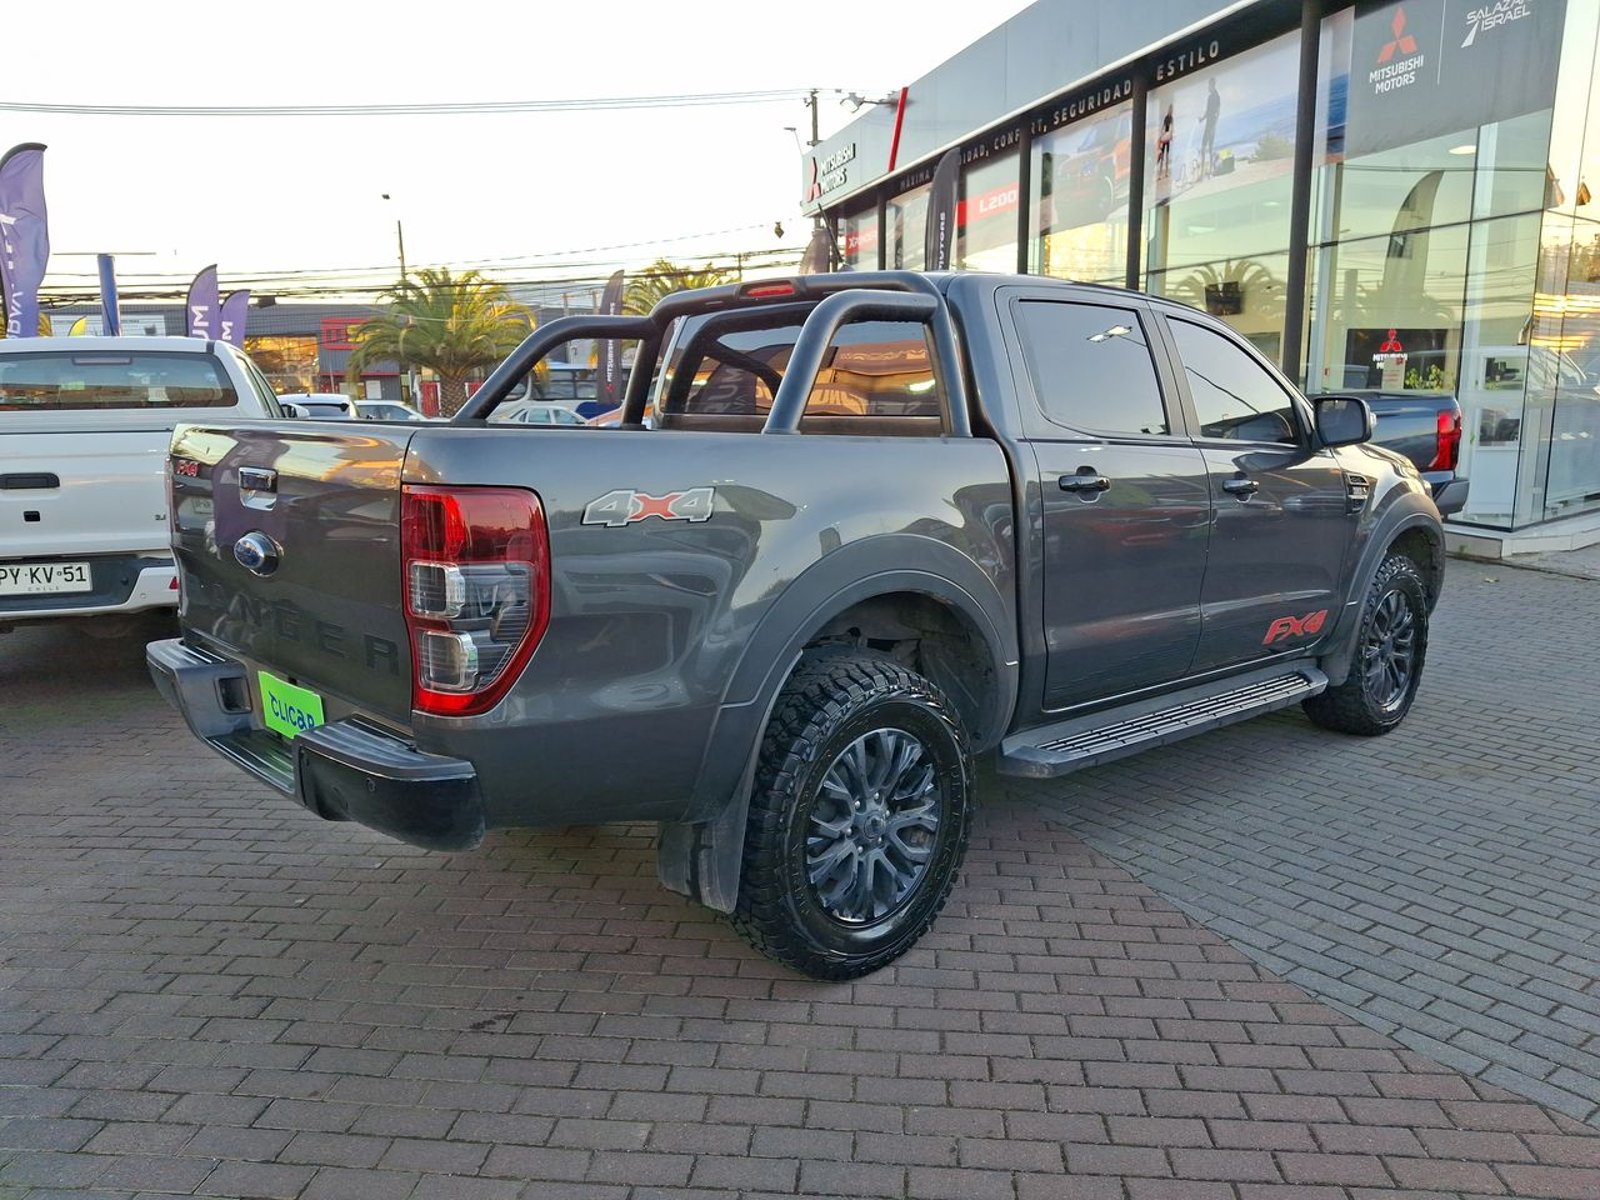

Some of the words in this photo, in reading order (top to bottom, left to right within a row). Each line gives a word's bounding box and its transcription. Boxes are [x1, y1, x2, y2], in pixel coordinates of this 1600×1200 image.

[1480, 4, 1531, 32] ISRAEL
[1369, 54, 1424, 83] MITSUBISHI
[1375, 71, 1416, 94] MOTORS
[1053, 79, 1131, 126] SEGURIDAD
[1157, 40, 1219, 81] ESTILO
[980, 190, 1017, 213] L200
[1262, 609, 1328, 645] FX4
